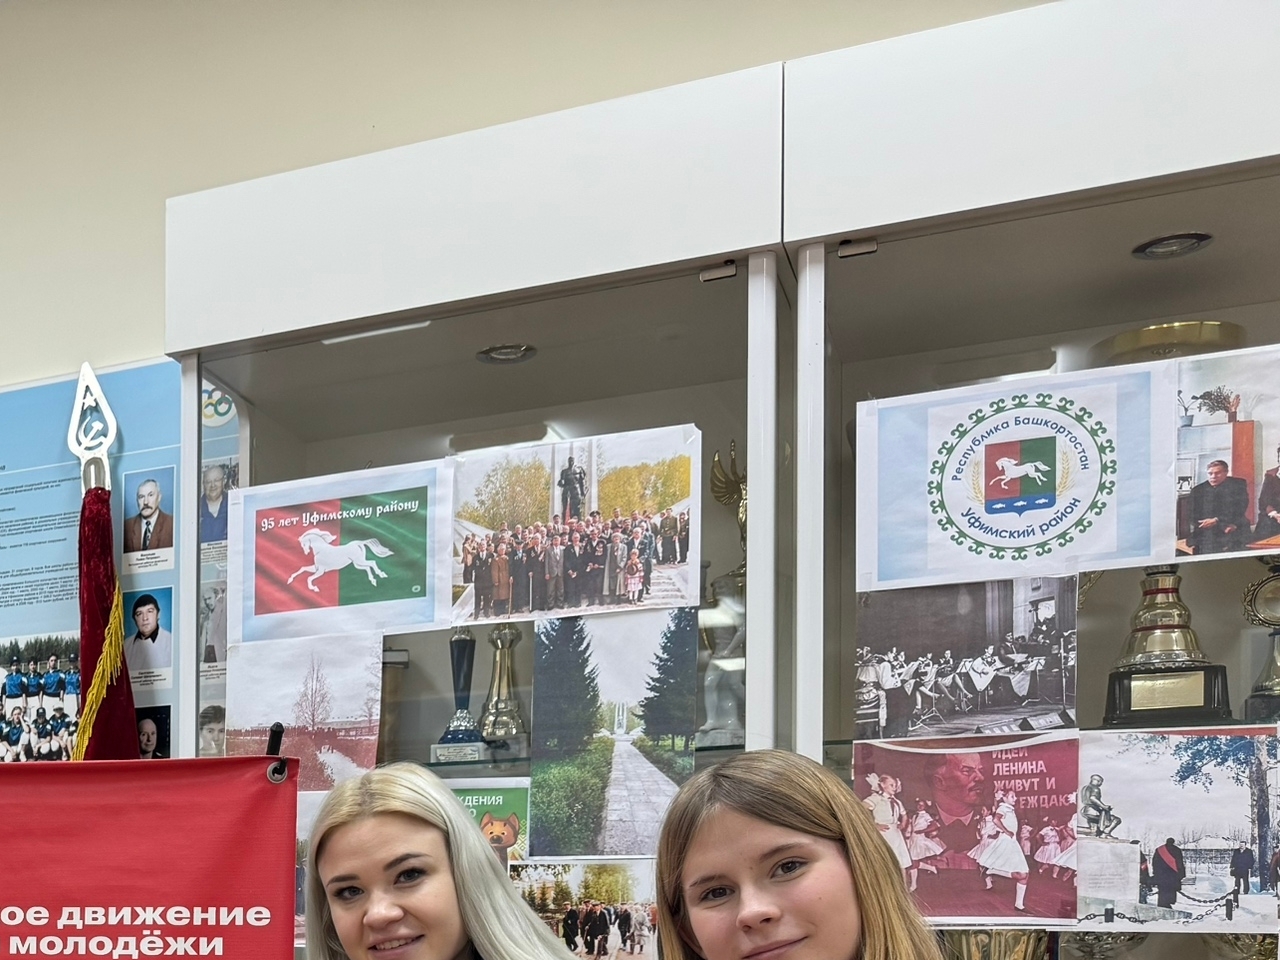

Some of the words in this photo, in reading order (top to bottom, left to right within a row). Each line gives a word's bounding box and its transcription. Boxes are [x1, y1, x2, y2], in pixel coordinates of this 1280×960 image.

[951, 419, 1010, 481] Республика
[1014, 416, 1091, 471] Башкортостан
[261, 517, 276, 532] 95
[277, 516, 300, 529] лет
[302, 506, 373, 527] Уфимскому
[376, 499, 419, 518] району
[961, 507, 1036, 540] Уфимский
[1039, 496, 1082, 536] район
[992, 760, 1047, 776] ЛЕНИНА
[993, 777, 1040, 793] ЖИВУТ
[1045, 777, 1056, 790] И
[56, 905, 272, 930] движение
[8, 930, 224, 960] молодёжи
